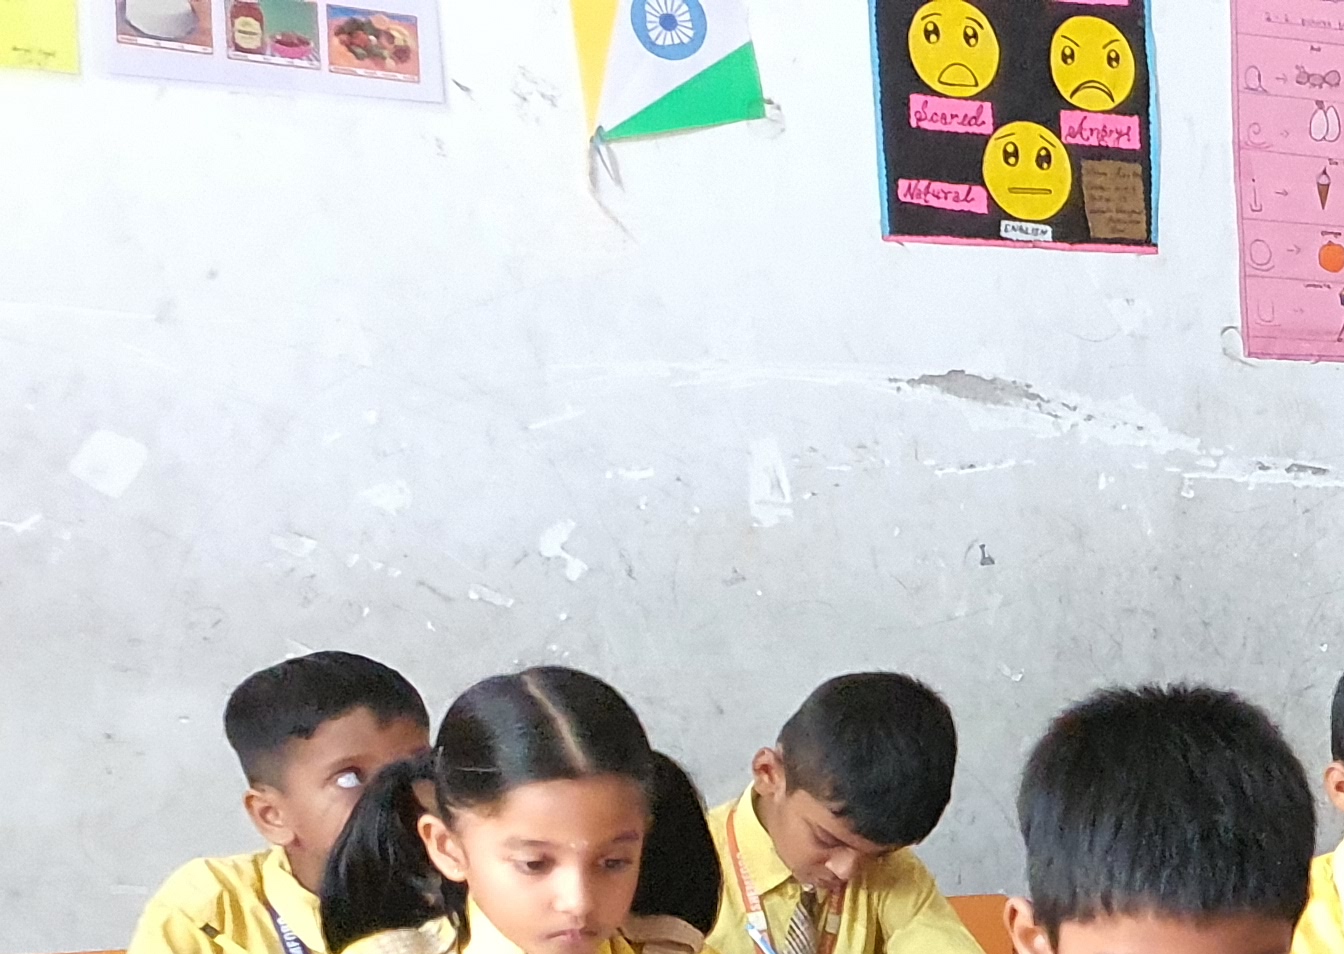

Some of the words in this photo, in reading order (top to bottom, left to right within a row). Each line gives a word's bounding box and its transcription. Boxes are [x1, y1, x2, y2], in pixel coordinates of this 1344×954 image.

[914, 100, 986, 127] Scared
[902, 181, 975, 204] Natural
[1003, 222, 1048, 237] ENGLISH
